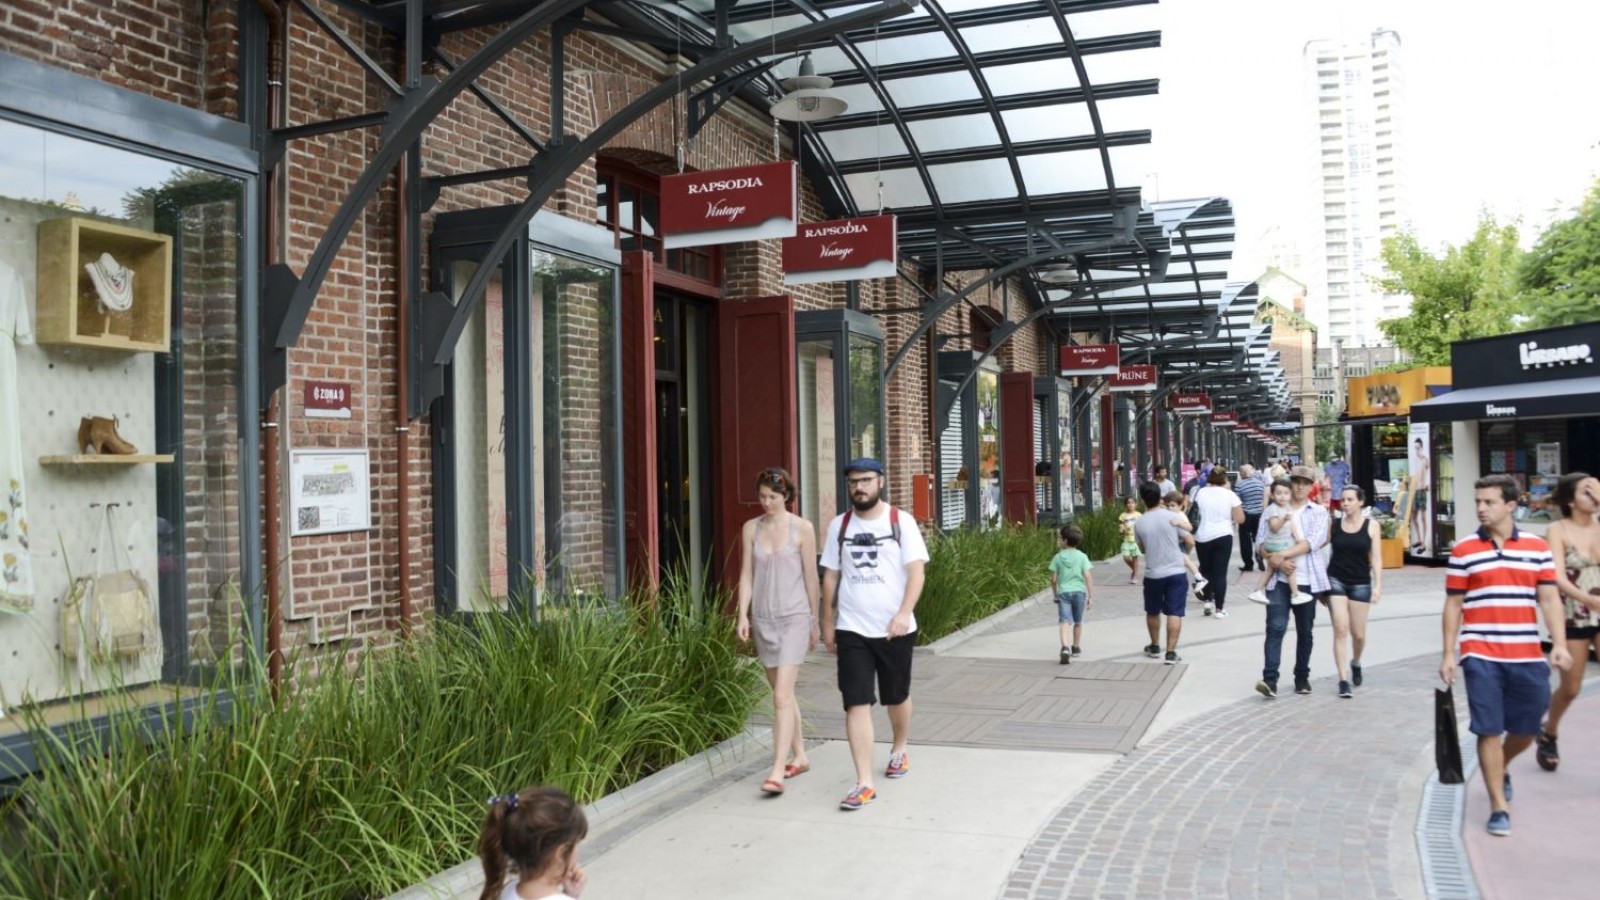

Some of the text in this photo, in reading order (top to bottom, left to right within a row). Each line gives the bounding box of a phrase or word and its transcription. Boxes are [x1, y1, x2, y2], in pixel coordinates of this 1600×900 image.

[688, 177, 763, 194] RAPSODIA
[705, 198, 746, 222] Vintage
[805, 224, 868, 238] RAPSODIA
[819, 241, 854, 261] Vintage
